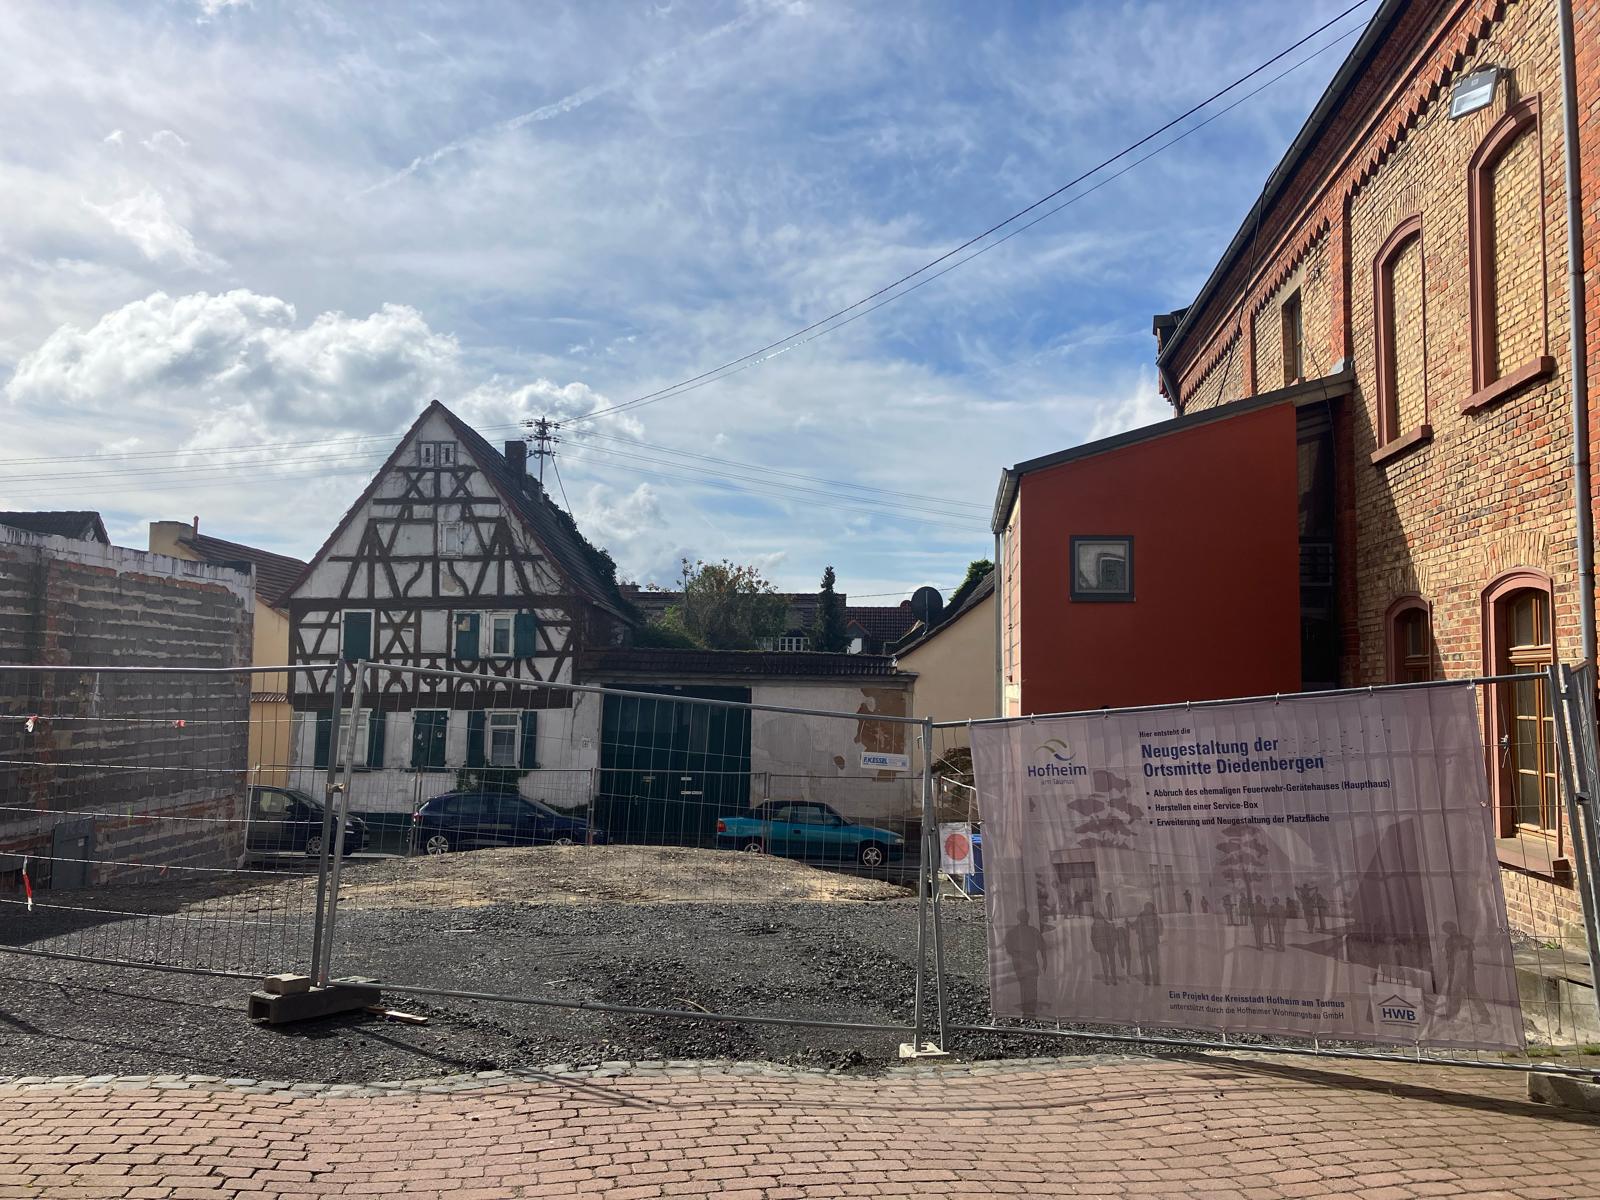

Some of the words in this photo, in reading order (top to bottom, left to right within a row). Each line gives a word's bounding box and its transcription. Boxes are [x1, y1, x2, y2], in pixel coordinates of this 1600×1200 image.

[1154, 729, 1179, 737] entsteht
[1141, 740, 1249, 760] Neugestaltung
[1254, 737, 1279, 752] der
[1027, 763, 1087, 777] Hofheim
[1143, 761, 1212, 777] Ortsmitte
[1216, 756, 1324, 774] Diedenbergen
[1154, 788, 1183, 798] Abbruch
[1184, 788, 1198, 796] des
[1200, 786, 1241, 796] ehemaligen
[1243, 783, 1340, 794] Feuerwehr-Gerätehauses
[1341, 779, 1391, 791] (Haupthaus)
[1155, 803, 1192, 812] Herstellen
[1213, 801, 1259, 810] Service-Box
[1157, 818, 1200, 827] Erweiterung
[1217, 815, 1271, 826] Neugestaltung
[1272, 815, 1285, 823] der
[1287, 813, 1330, 823] Platzfläche
[1169, 991, 1181, 999] Ein
[1182, 991, 1209, 1002] Projekt
[1210, 994, 1224, 1002] der
[1225, 994, 1265, 1004] Kreisstadt
[1266, 996, 1300, 1006] Hofheim
[1301, 999, 1314, 1007] am
[1316, 999, 1345, 1008] Taunus
[1322, 1011, 1344, 1020] GmbH
[1382, 1008, 1416, 1021] HWB
